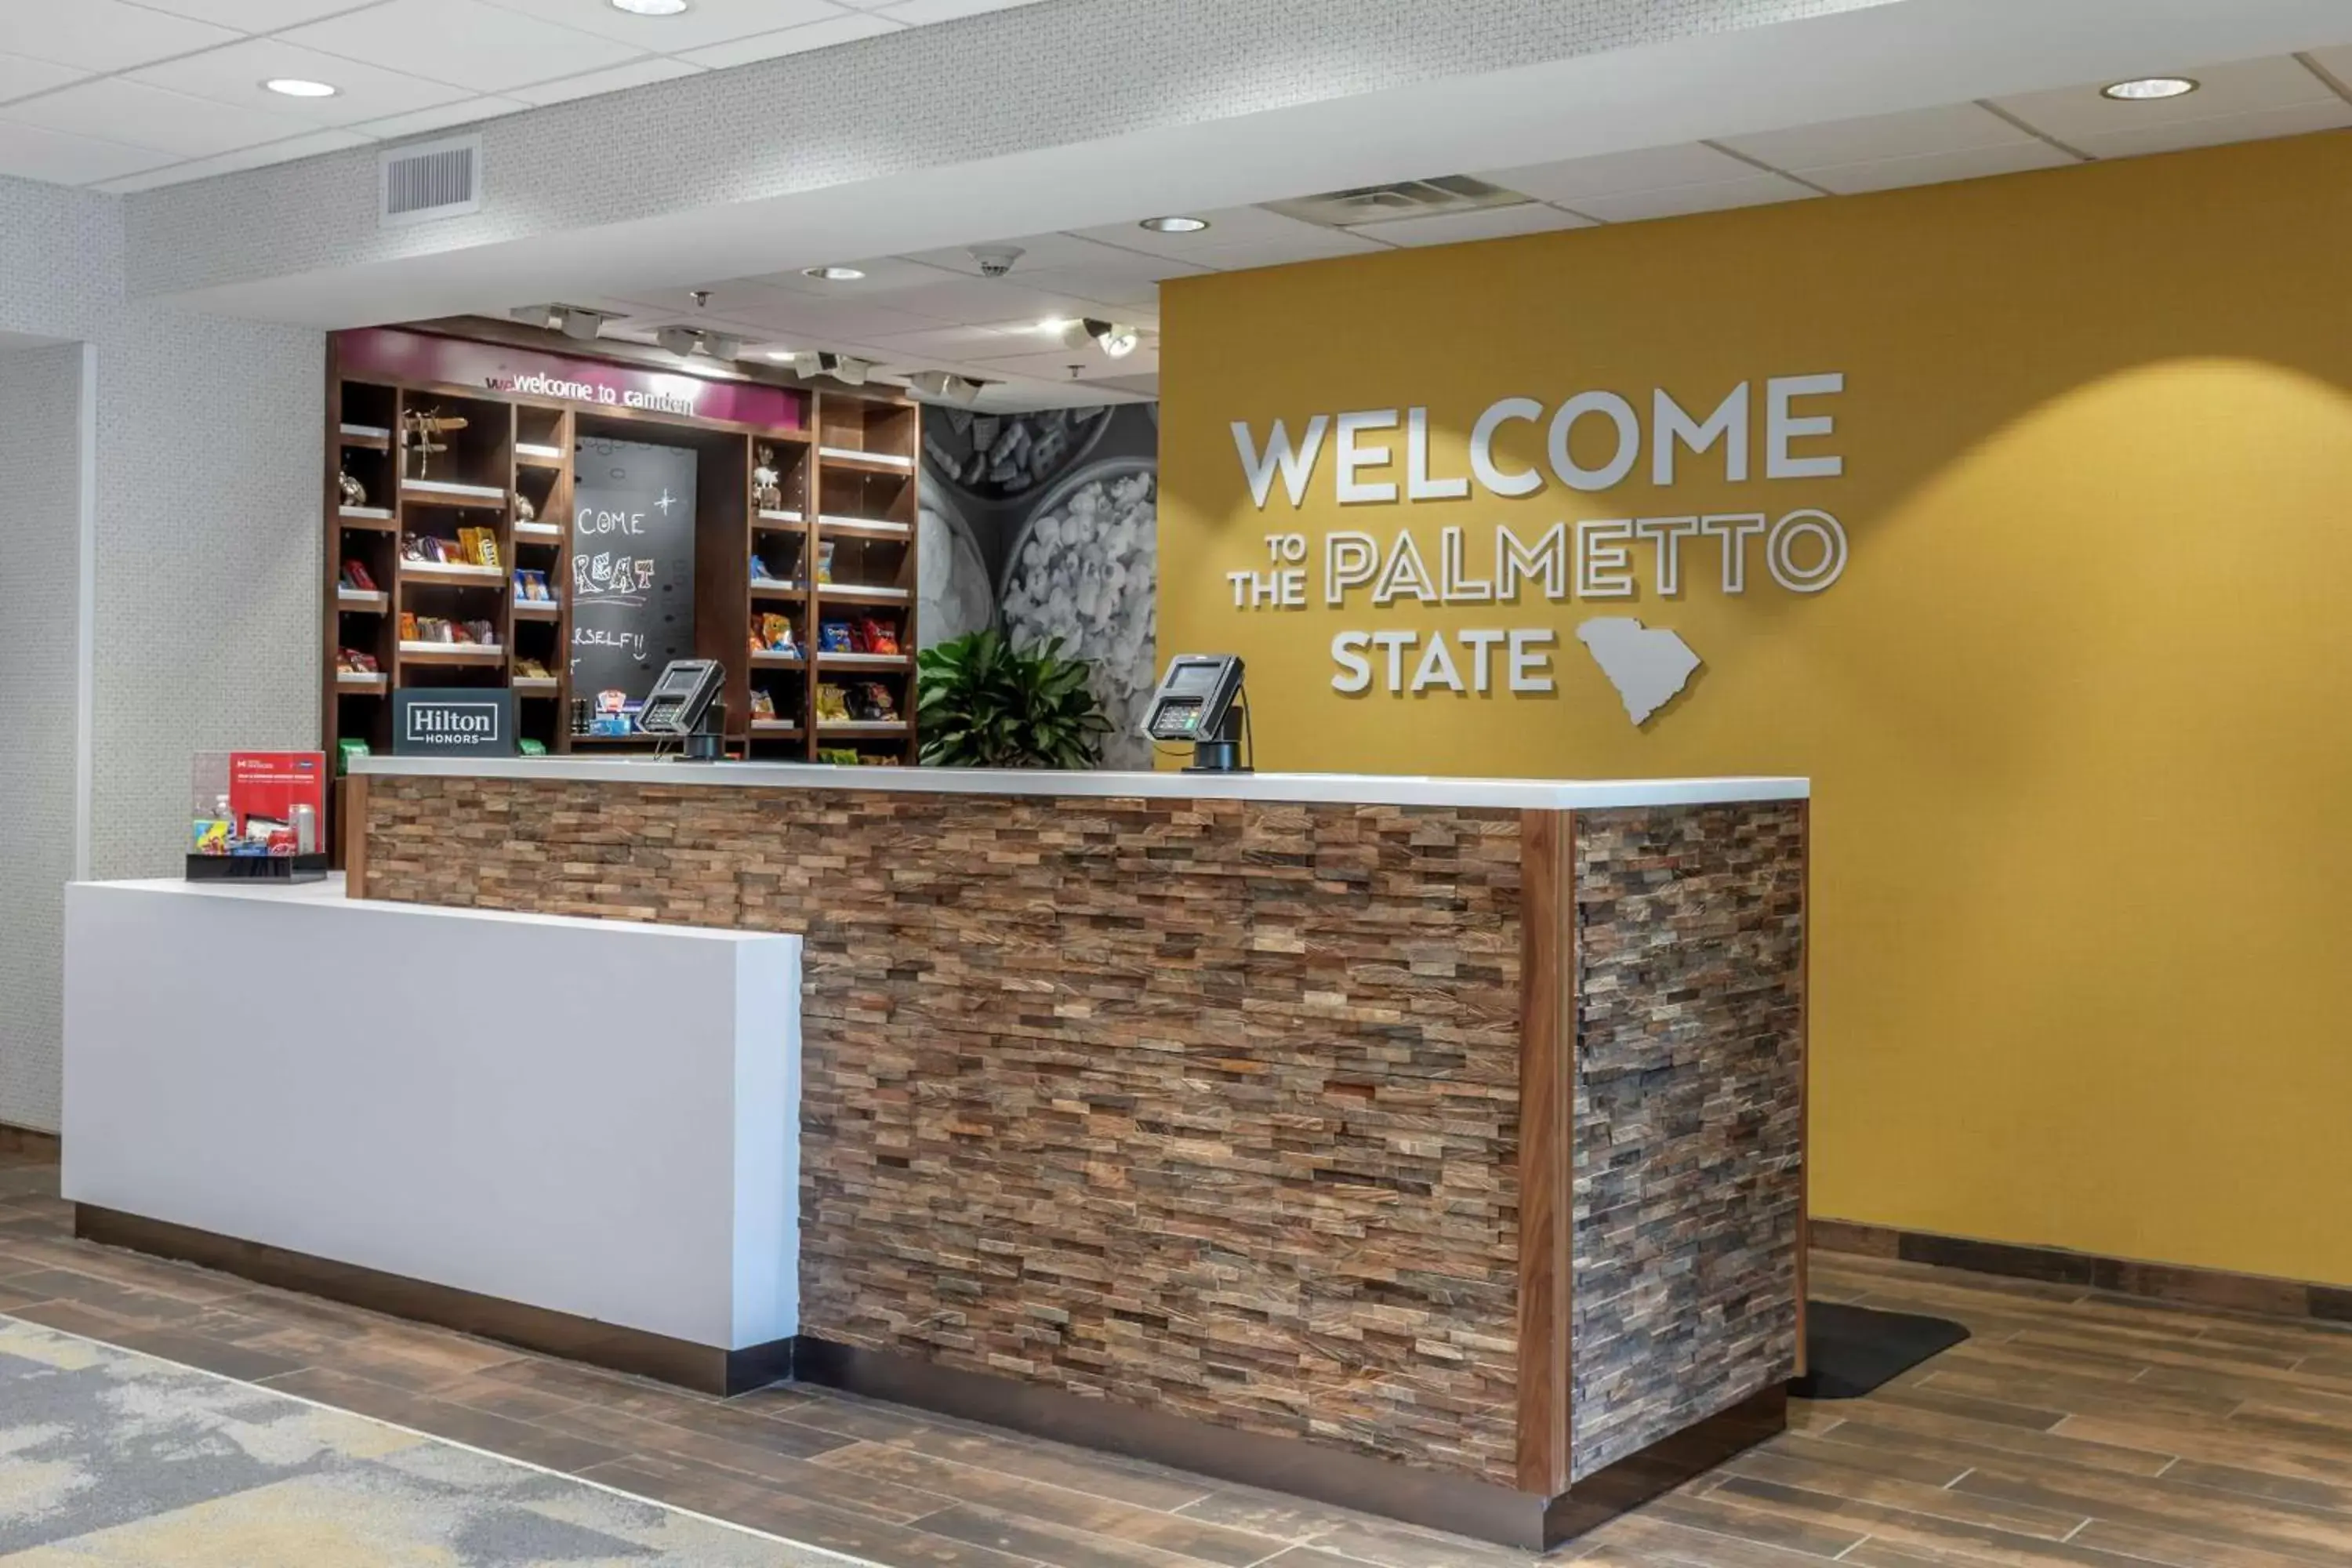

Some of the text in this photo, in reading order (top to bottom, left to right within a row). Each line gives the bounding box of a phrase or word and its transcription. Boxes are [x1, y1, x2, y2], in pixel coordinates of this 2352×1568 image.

[514, 372, 592, 401] welcome
[598, 383, 615, 403] to
[1231, 373, 1844, 508] WELCOME
[579, 508, 645, 535] COME
[1264, 534, 1305, 561] TO
[1325, 509, 1848, 603] PALMETTO
[1226, 570, 1305, 606] THE
[1331, 630, 1553, 692] STATE
[415, 710, 490, 731] Hilton
[426, 735, 479, 743] HONORS
